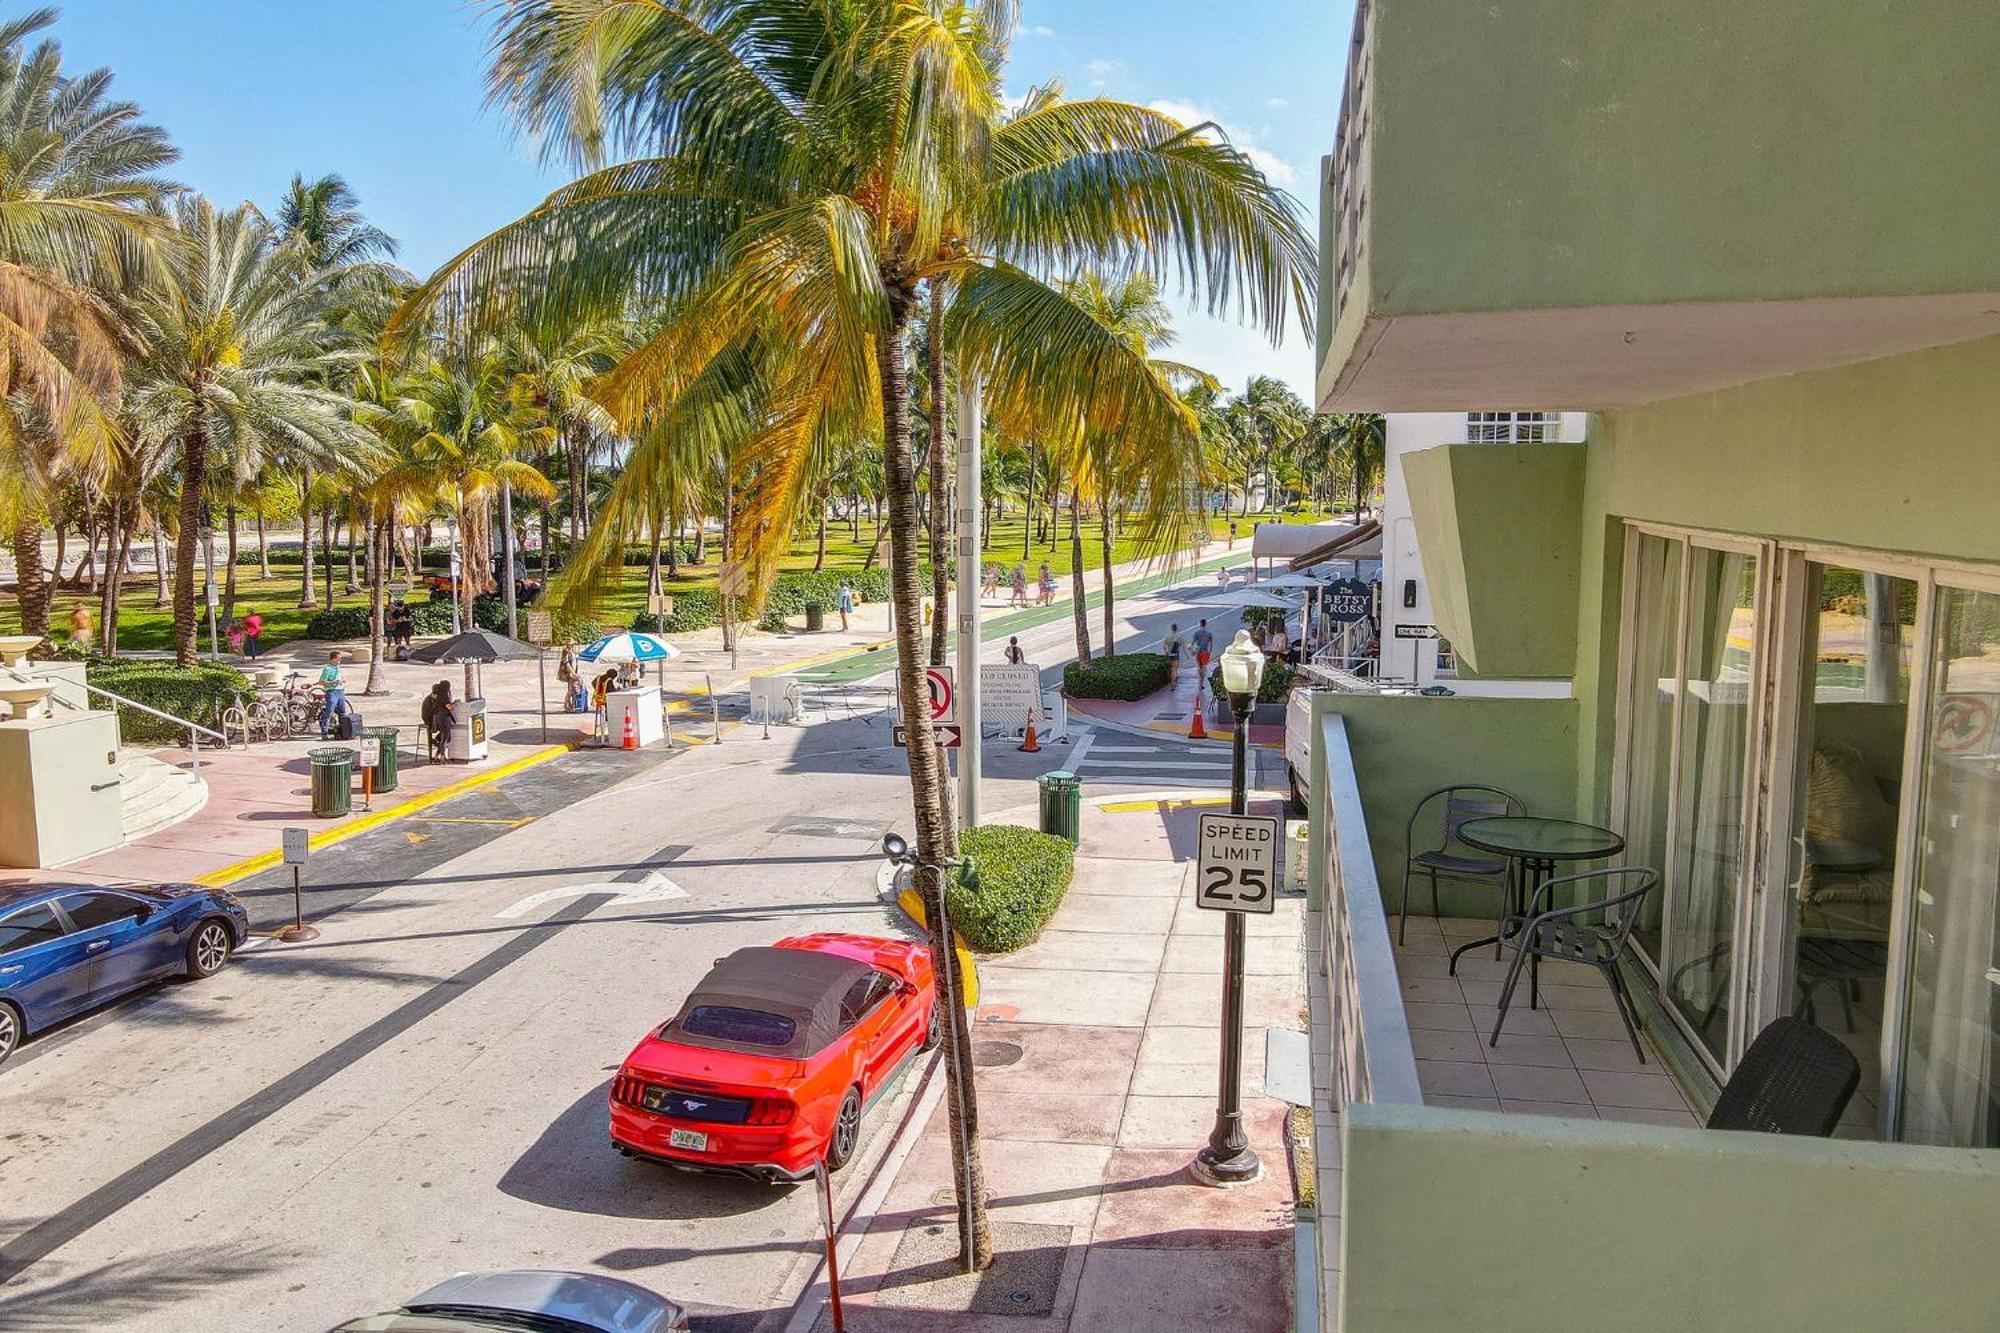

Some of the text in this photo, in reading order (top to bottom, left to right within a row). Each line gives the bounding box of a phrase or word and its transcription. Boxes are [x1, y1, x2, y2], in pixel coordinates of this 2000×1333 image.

[1324, 594, 1370, 604] BETSY
[1329, 604, 1365, 613] ROSS
[1206, 825, 1270, 841] SPEED
[1212, 845, 1262, 861] LIMIT
[1204, 866, 1267, 902] 25
